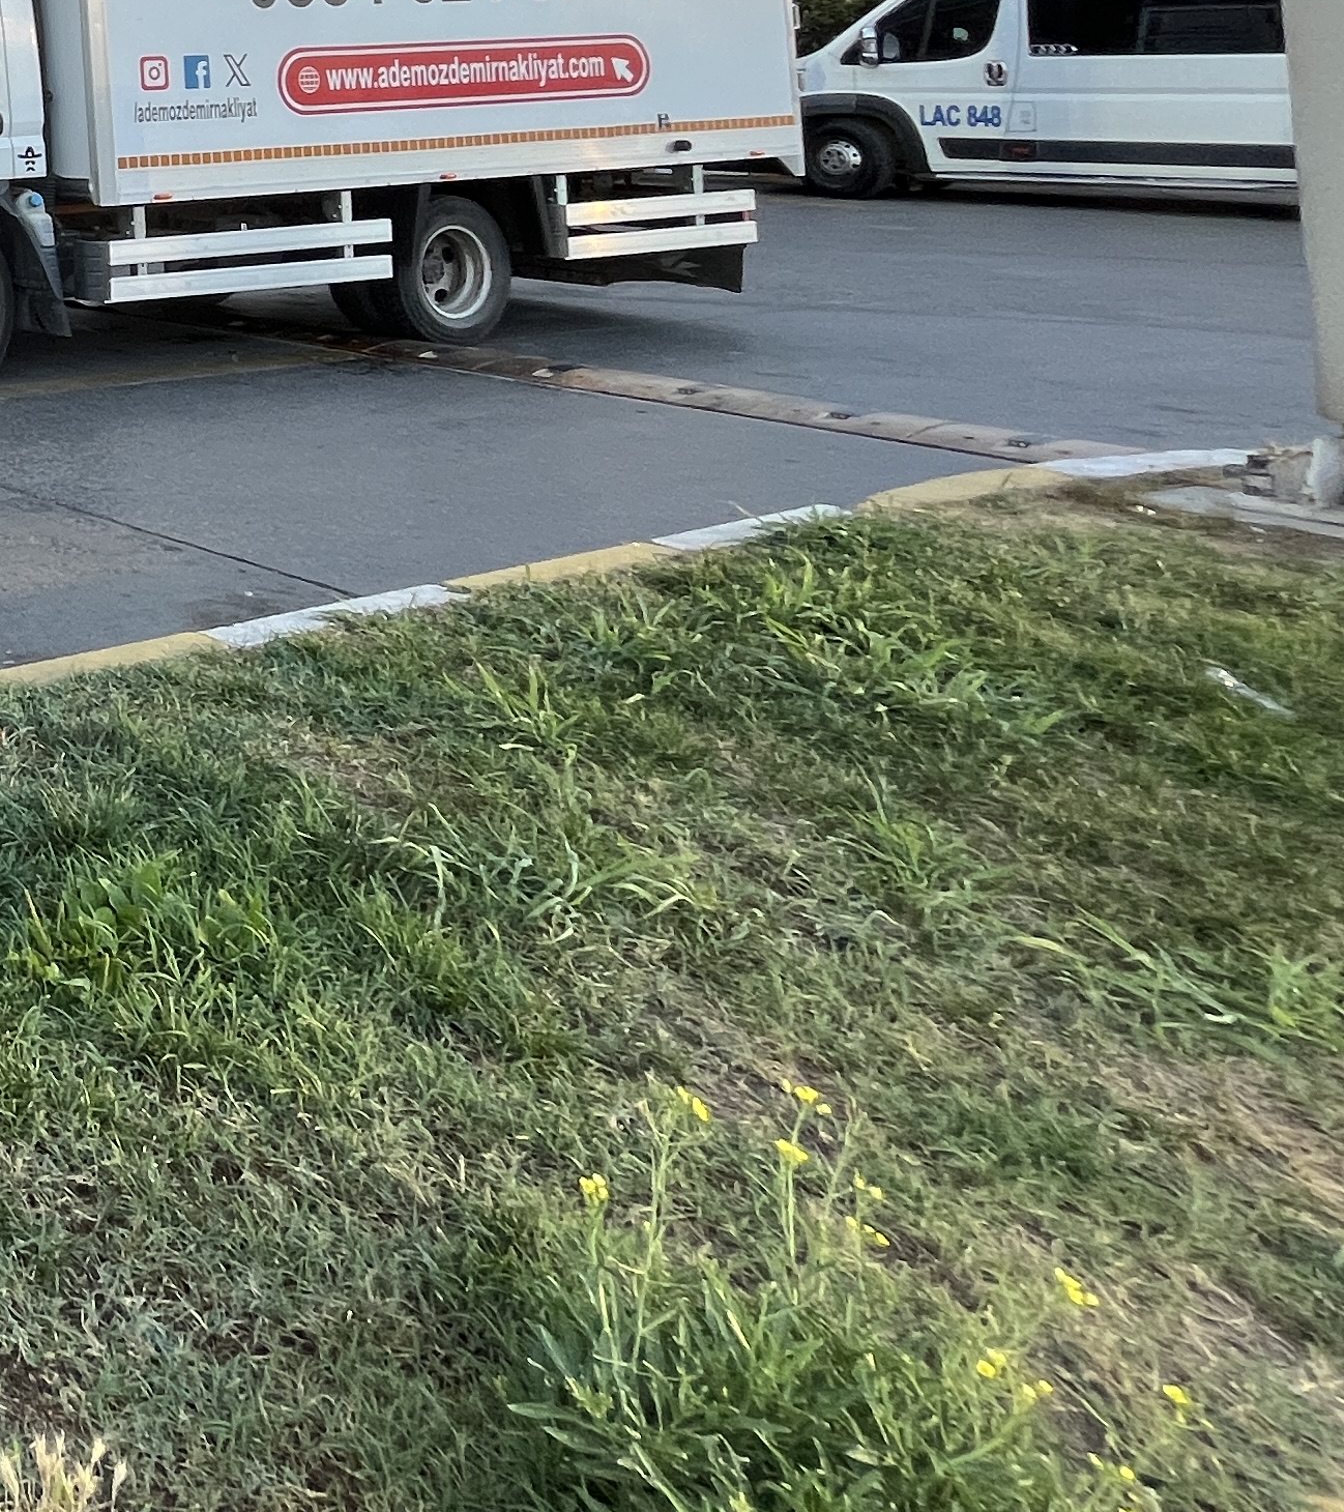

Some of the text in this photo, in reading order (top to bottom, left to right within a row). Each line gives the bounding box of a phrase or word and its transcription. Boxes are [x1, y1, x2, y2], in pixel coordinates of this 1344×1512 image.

[326, 57, 606, 94] www.ademozdemirnakliyat.com
[919, 105, 1002, 127] LAC 848
